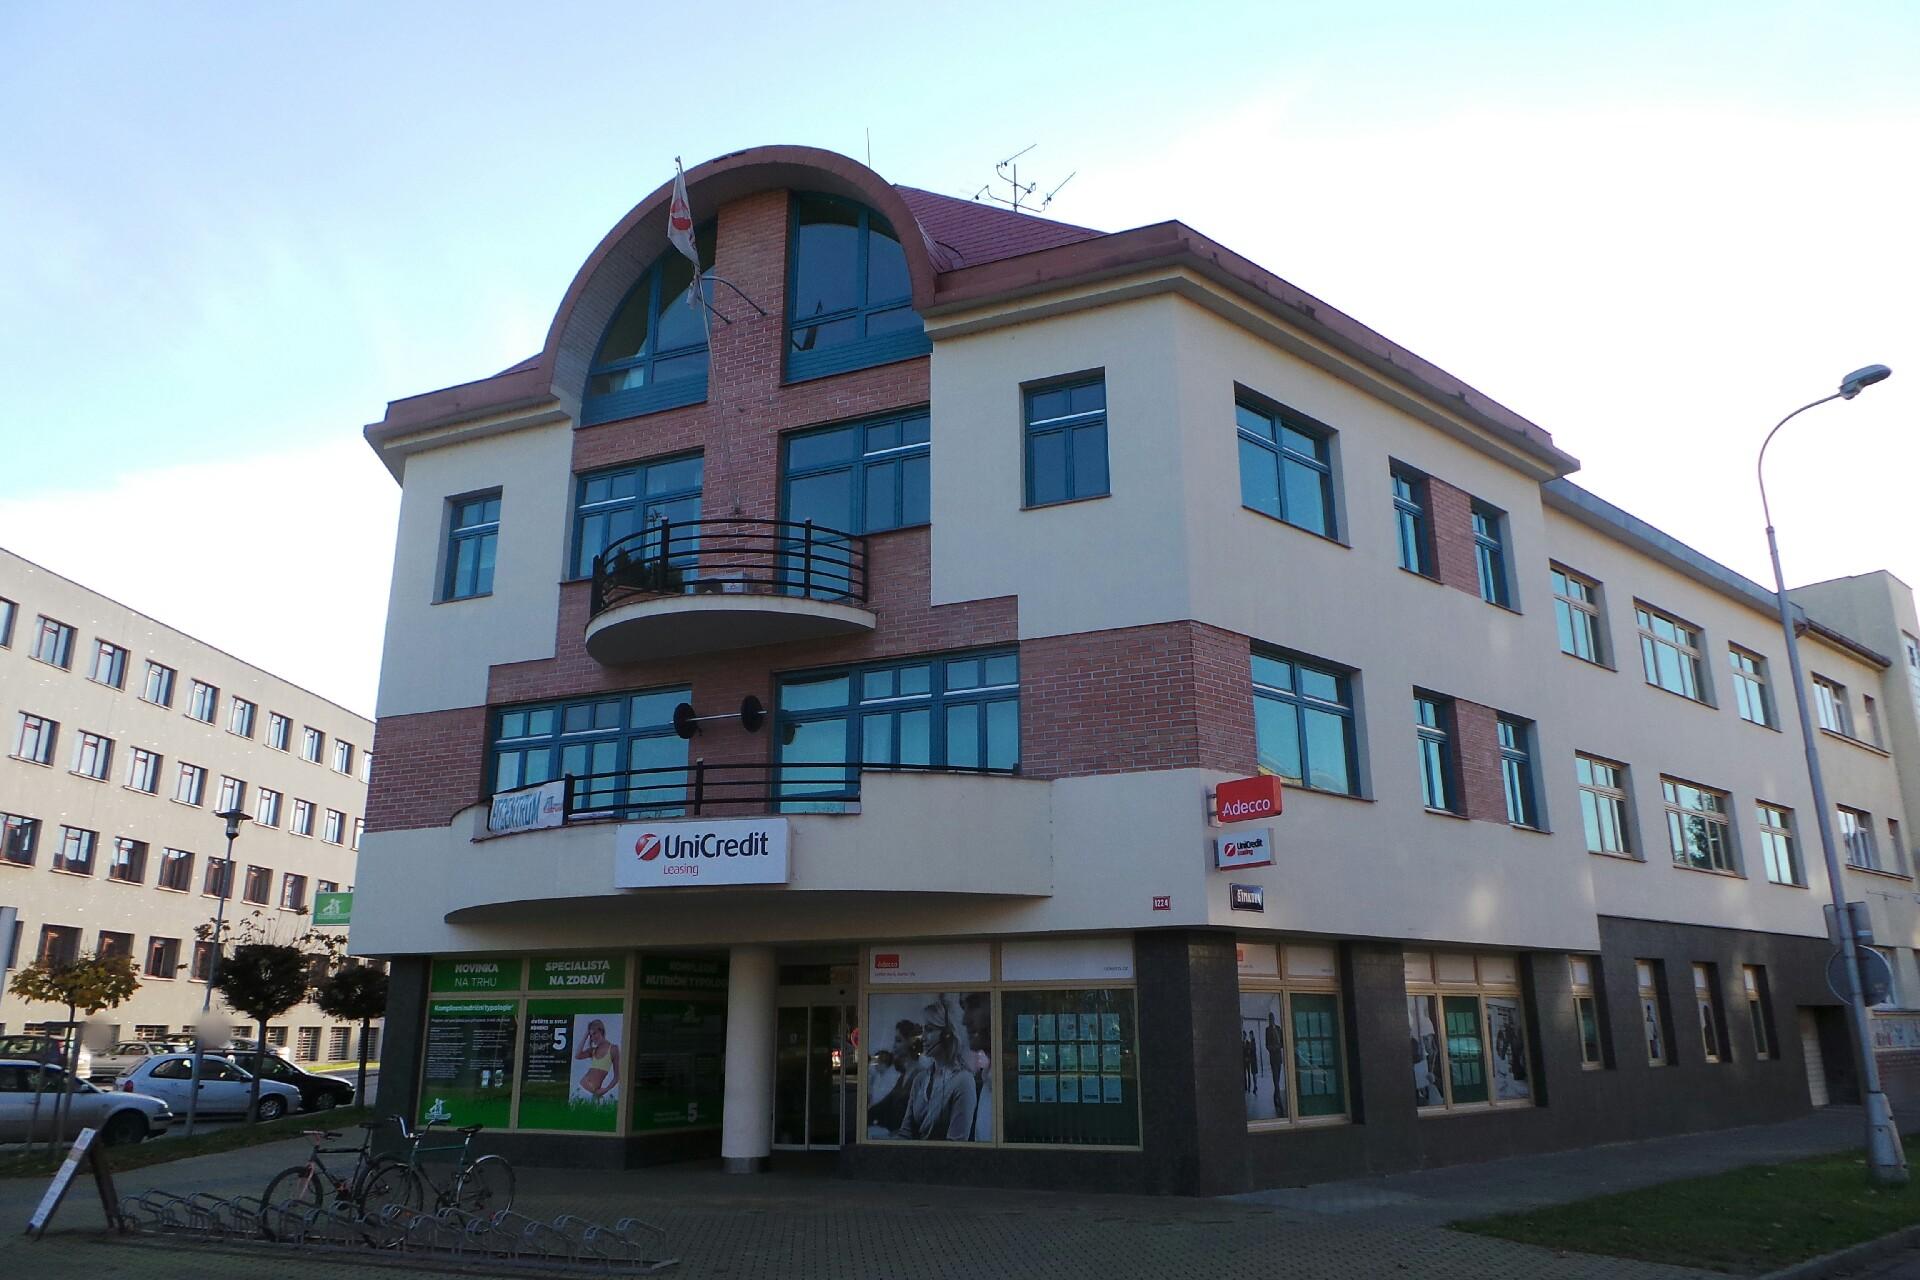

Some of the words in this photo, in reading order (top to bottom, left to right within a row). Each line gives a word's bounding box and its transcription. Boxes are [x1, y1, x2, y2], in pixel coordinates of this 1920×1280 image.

[1222, 799, 1270, 816] Adecco
[664, 832, 769, 859] UniCredit
[1236, 838, 1263, 850] UniCredit
[663, 863, 699, 876] Leasing
[1154, 898, 1169, 908] 1224
[455, 963, 499, 973] NOVINKA
[544, 960, 610, 972] SPECIALISTA
[454, 978, 468, 987] NA
[471, 977, 497, 987] TRHU
[549, 975, 564, 985] NA
[566, 972, 606, 985] ZDRAVÍ
[552, 1027, 567, 1051] 5
[687, 1102, 699, 1122] 5
